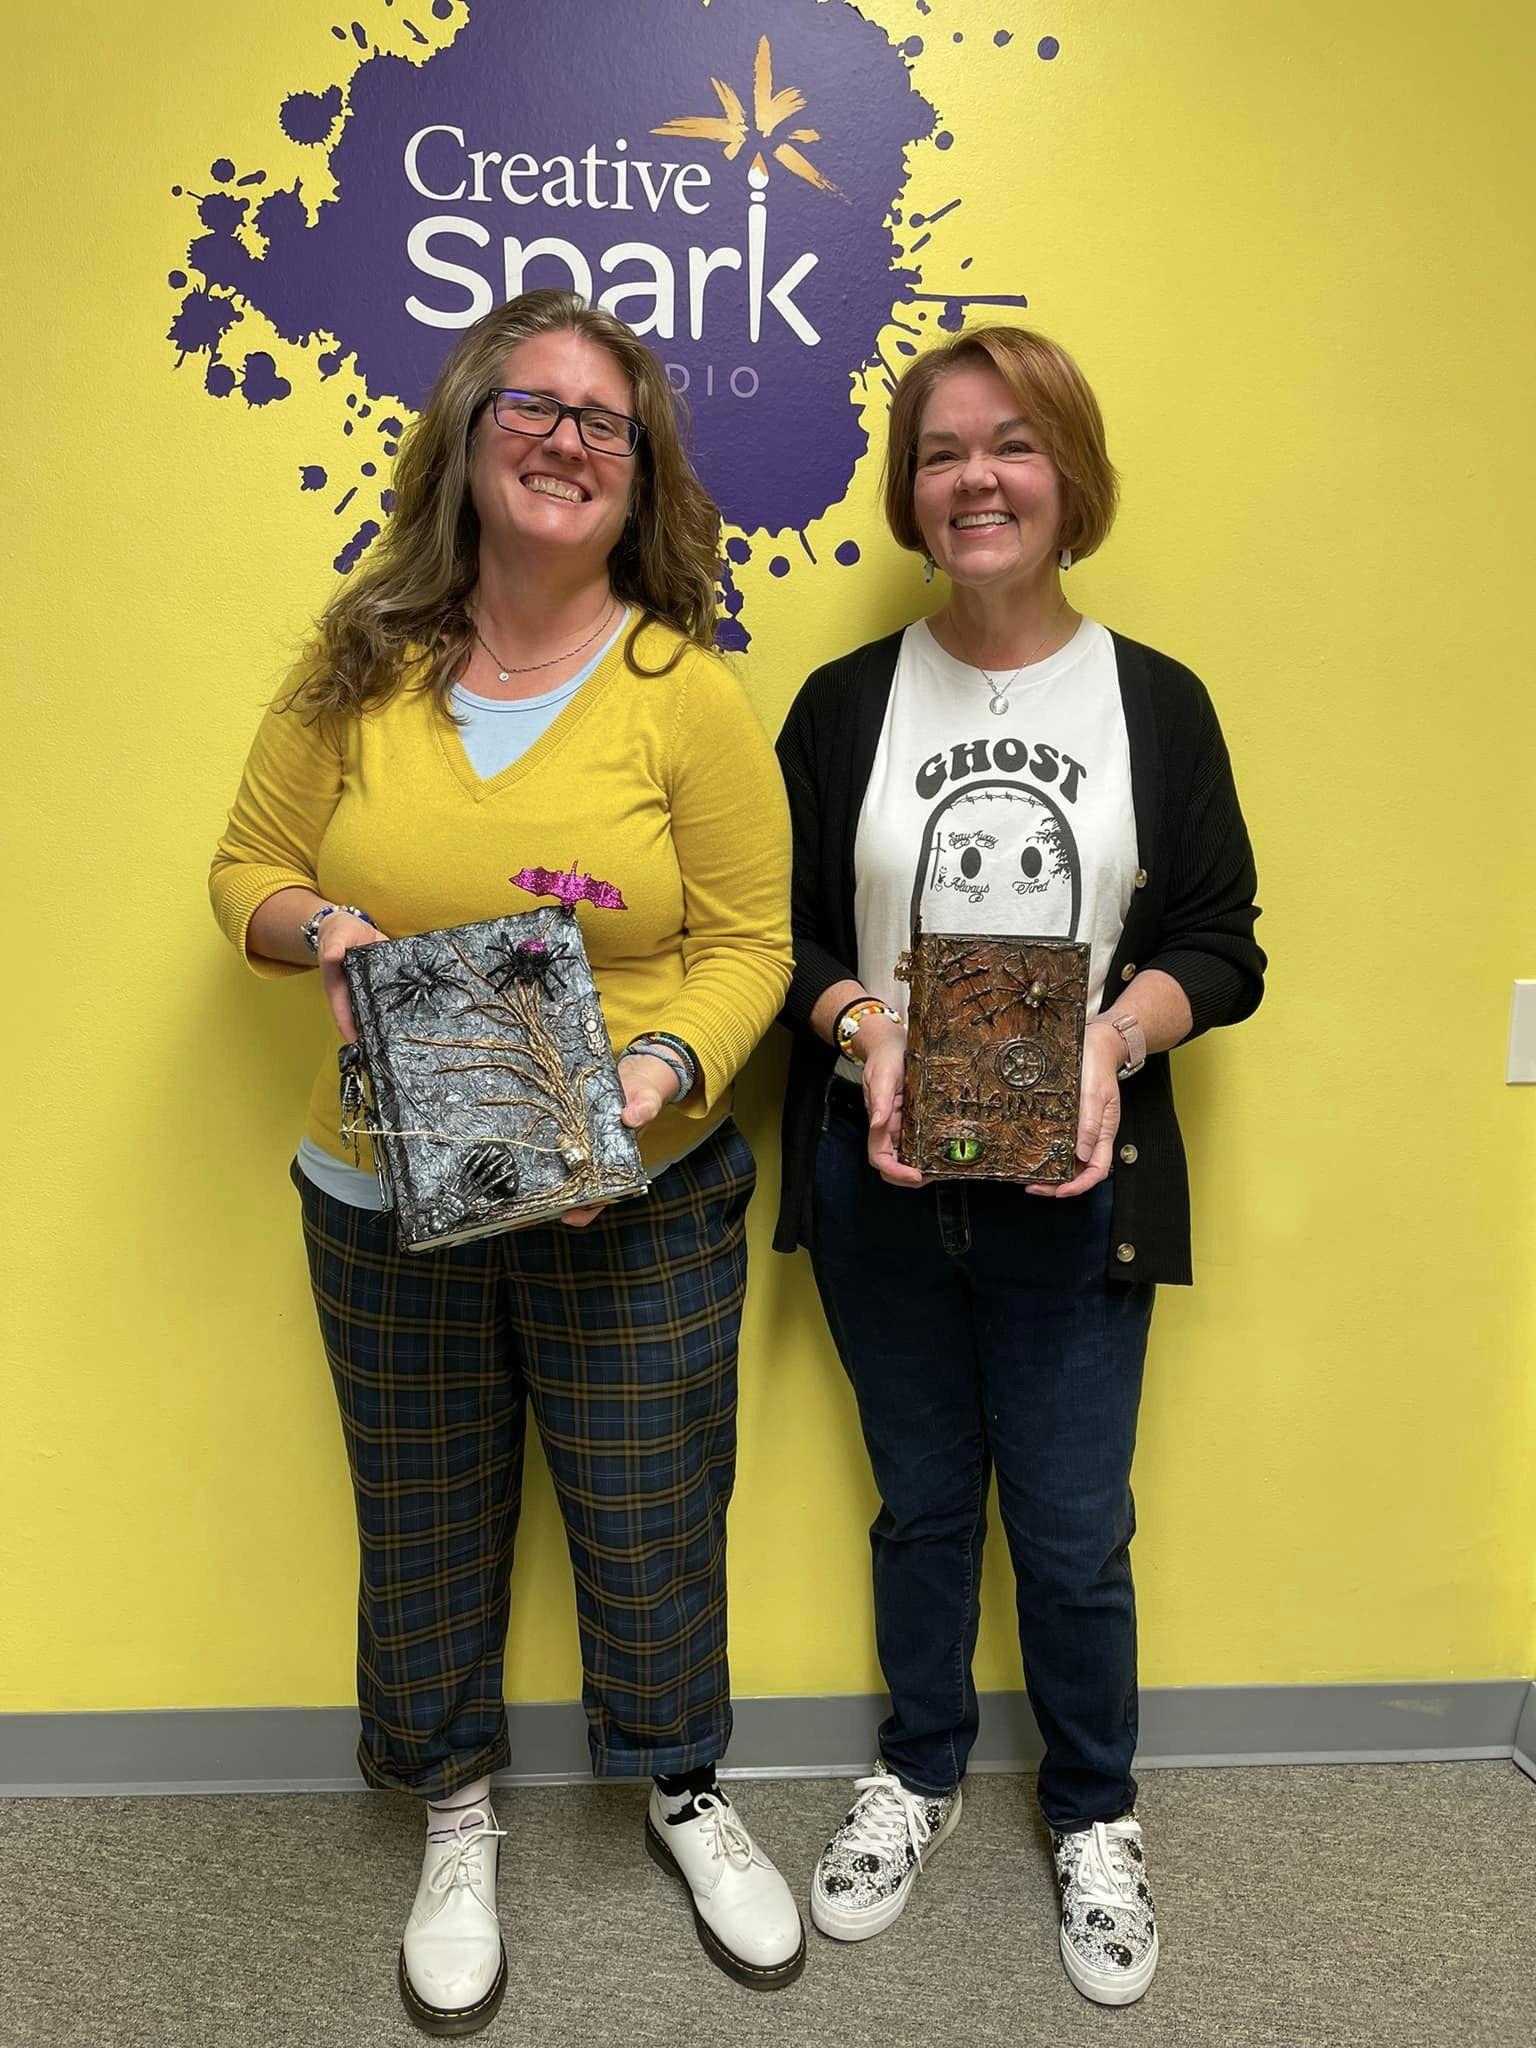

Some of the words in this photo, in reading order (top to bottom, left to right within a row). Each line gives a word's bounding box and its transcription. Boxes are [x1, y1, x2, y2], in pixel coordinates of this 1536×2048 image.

[404, 125, 712, 215] Creative
[664, 363, 760, 399] DIO
[915, 738, 1088, 805] GHOST
[969, 830, 1000, 849] Away
[944, 877, 990, 903] Always
[1012, 878, 1050, 895] Tired
